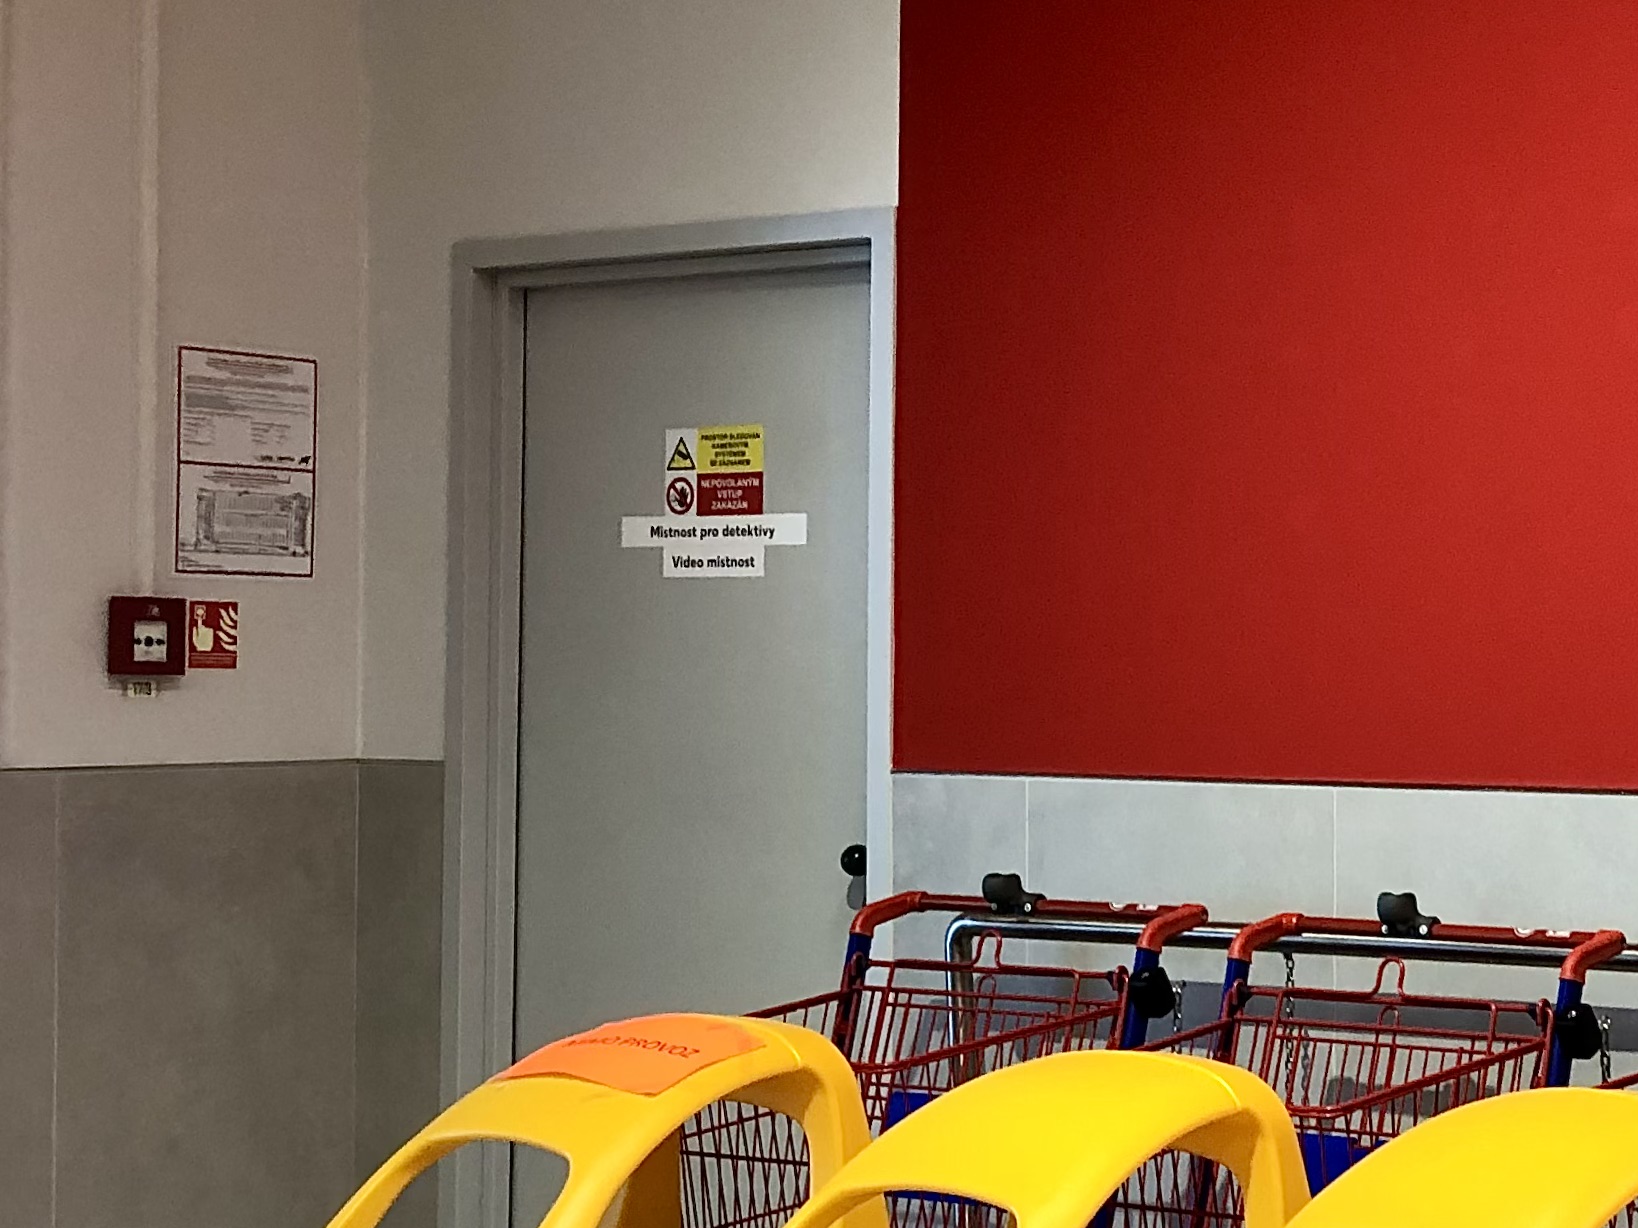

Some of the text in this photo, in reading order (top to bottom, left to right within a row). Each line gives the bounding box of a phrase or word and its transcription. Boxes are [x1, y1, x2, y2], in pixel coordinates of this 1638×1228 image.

[700, 526, 719, 540] pro
[722, 525, 776, 540] detektivy
[671, 555, 704, 569] Video
